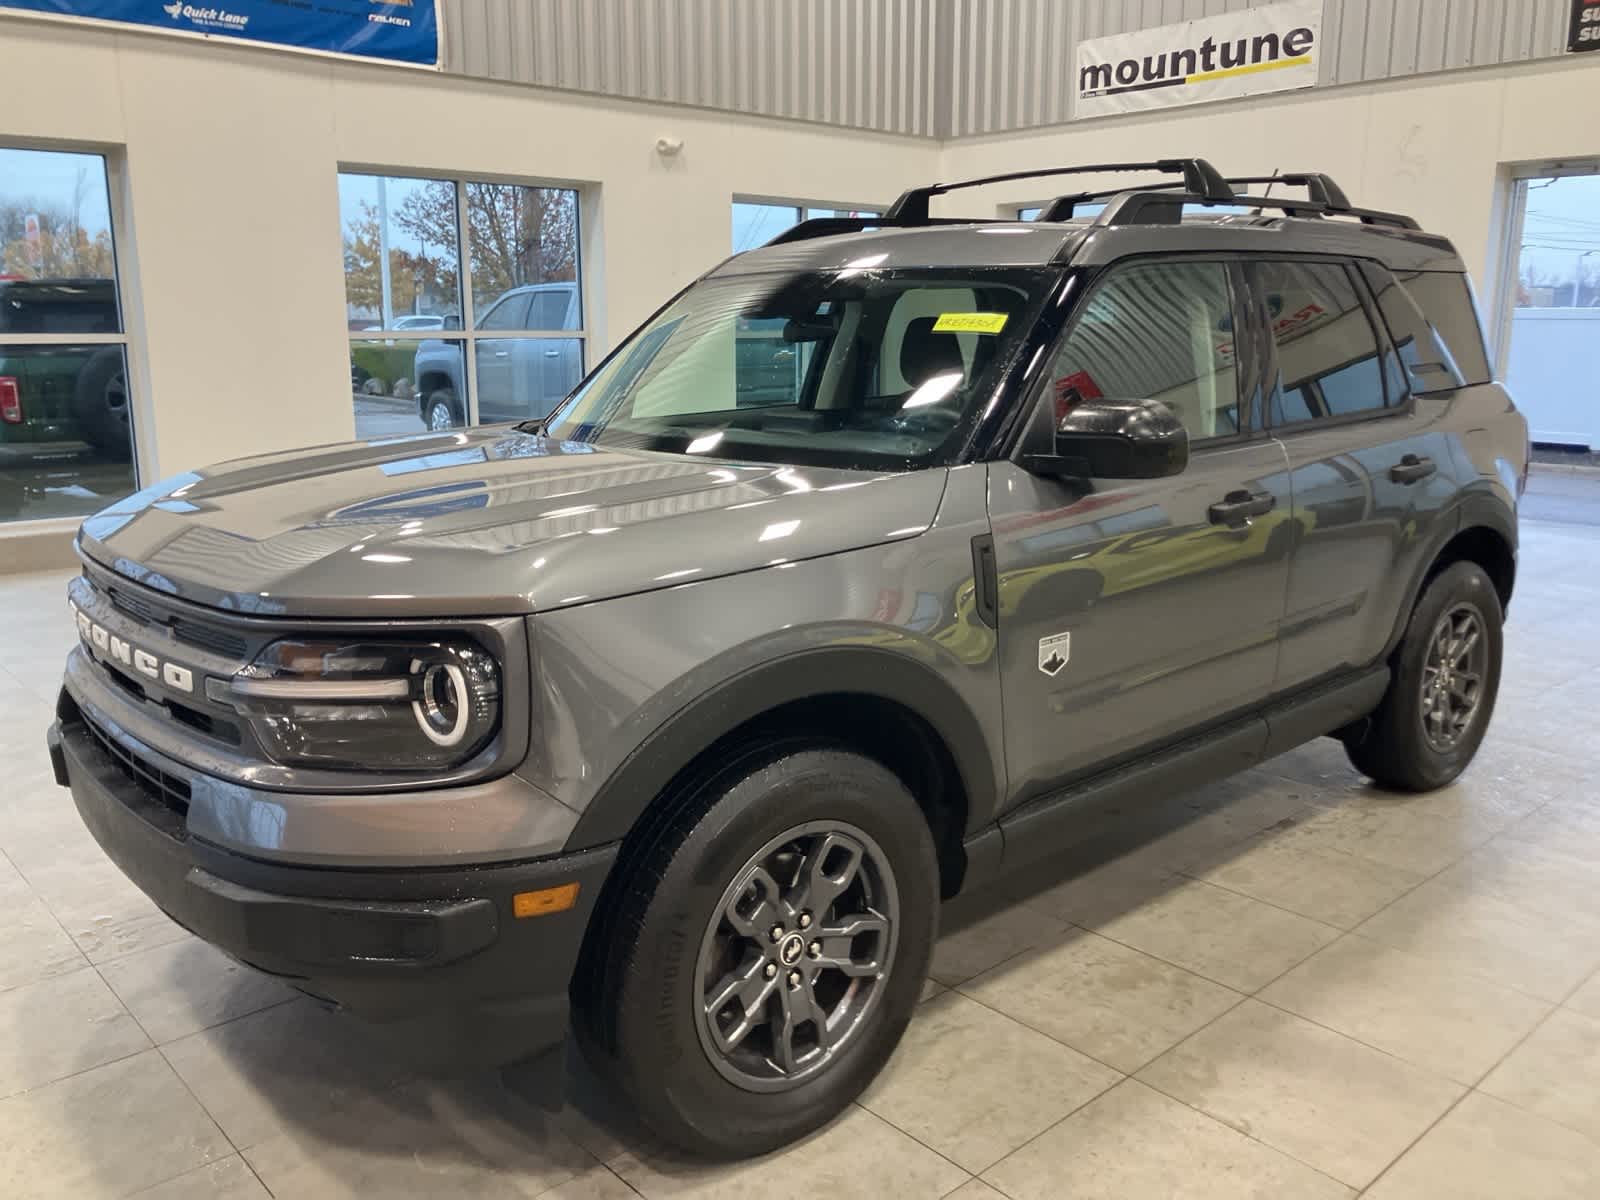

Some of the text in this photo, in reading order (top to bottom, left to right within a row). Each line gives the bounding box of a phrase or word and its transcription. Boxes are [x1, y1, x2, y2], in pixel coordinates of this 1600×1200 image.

[182, 5, 217, 19] Quick
[218, 10, 249, 25] Lane
[1079, 27, 1314, 91] mountune
